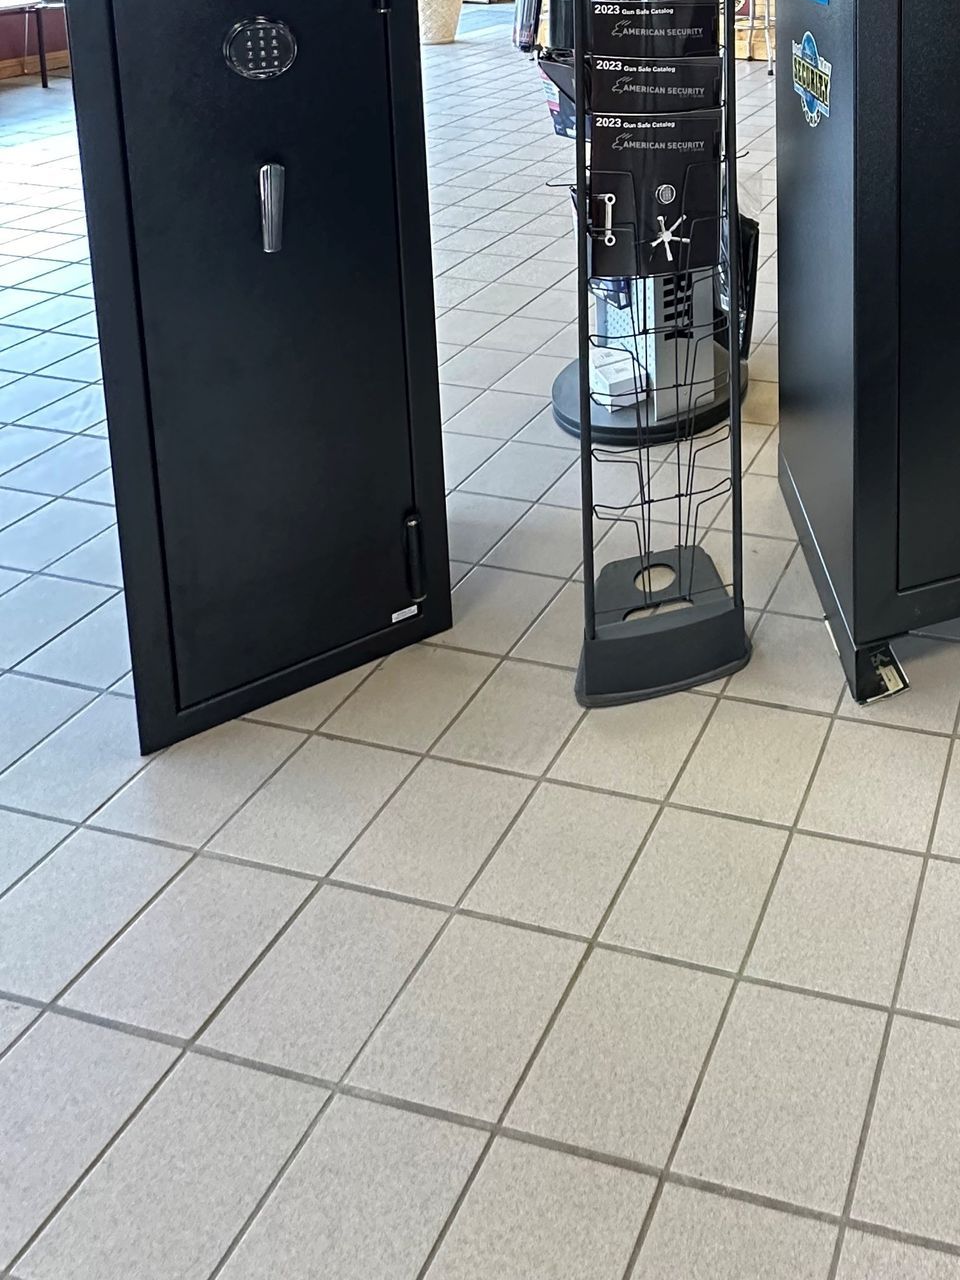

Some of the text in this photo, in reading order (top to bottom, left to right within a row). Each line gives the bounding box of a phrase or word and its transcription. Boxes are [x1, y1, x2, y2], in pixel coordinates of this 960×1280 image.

[594, 5, 620, 14] 2023
[651, 7, 674, 15] Catalog
[622, 27, 703, 36] AMERICAN SECURITY
[596, 60, 622, 70] 2023
[793, 54, 829, 106] SECURITY
[623, 84, 705, 95] AMERICAN SECURITY
[596, 117, 621, 127] 2023
[623, 140, 666, 149] AMERICAN
[667, 141, 705, 149] SECURITY
